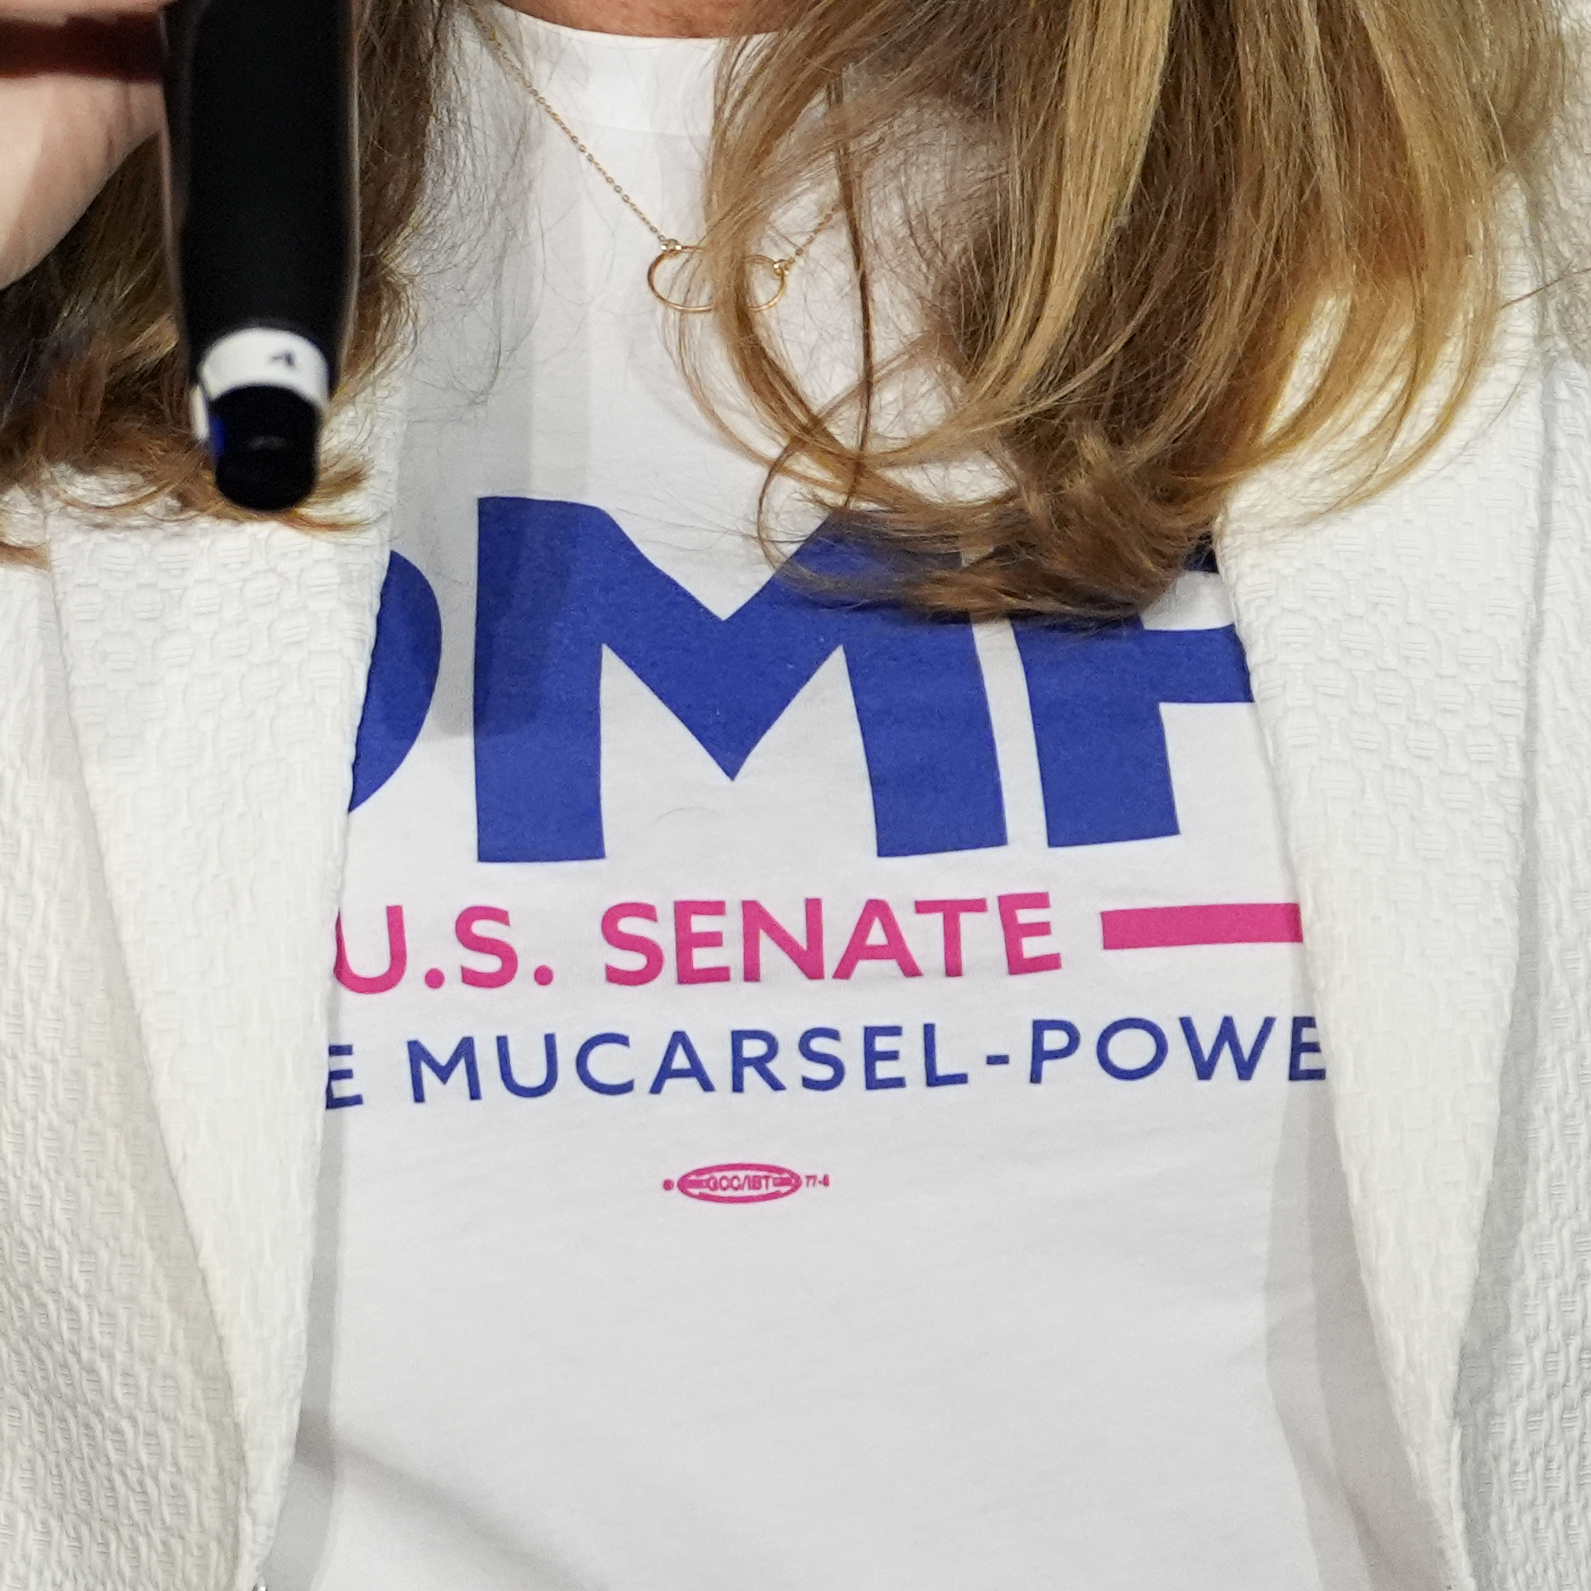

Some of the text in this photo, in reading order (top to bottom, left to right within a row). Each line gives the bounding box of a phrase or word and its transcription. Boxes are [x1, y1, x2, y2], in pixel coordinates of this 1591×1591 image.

[334, 891, 1062, 995] U.S. SENATE
[407, 1015, 1326, 1104] MUCARSEL-POWE
